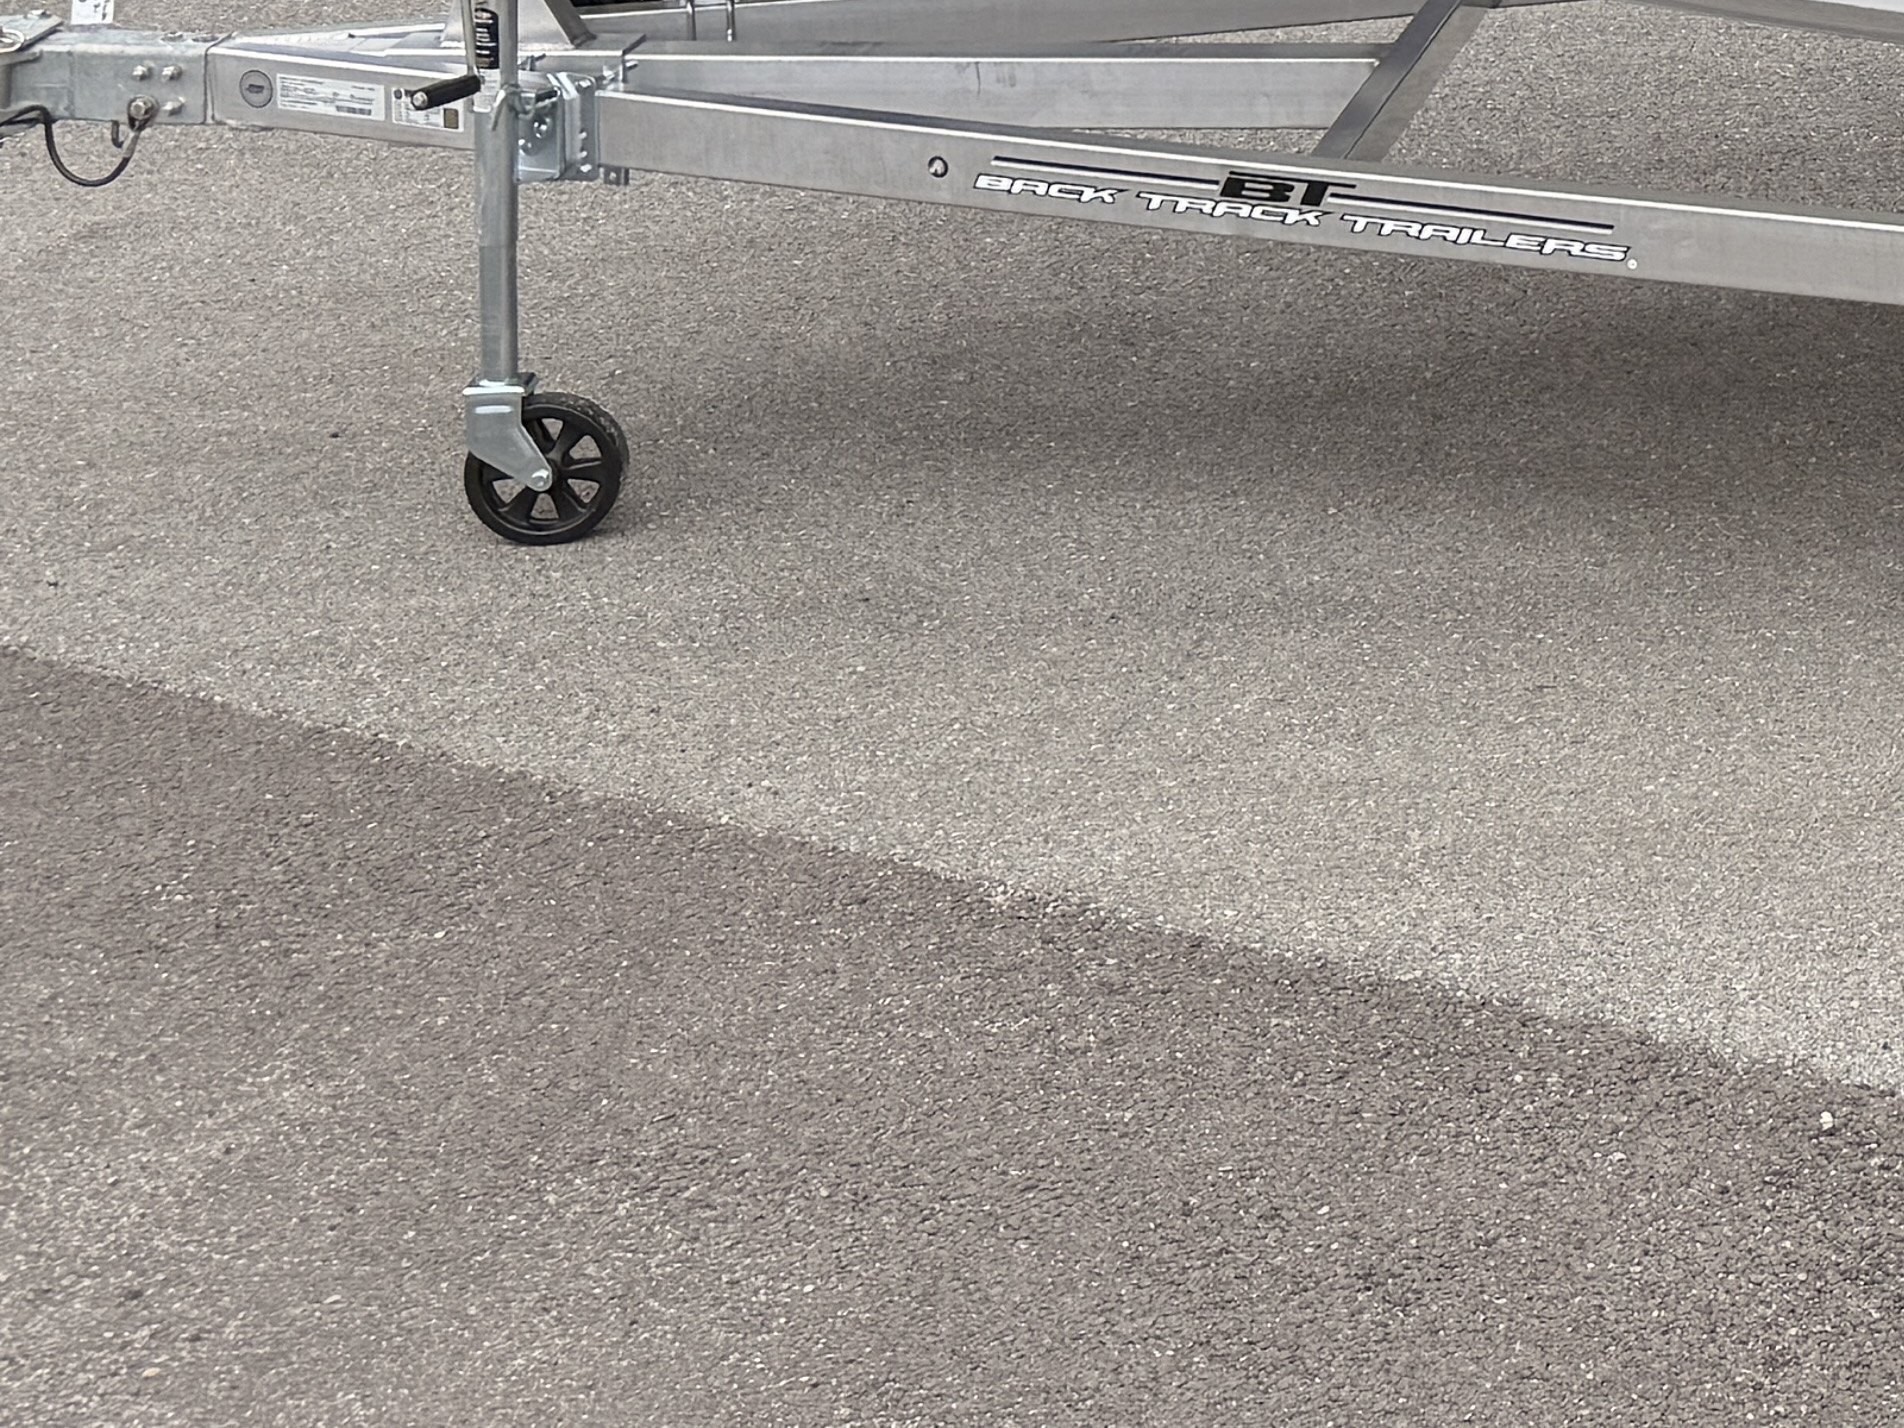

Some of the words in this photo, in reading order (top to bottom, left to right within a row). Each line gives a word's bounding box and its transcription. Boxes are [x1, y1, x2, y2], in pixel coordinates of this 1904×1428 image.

[973, 171, 1128, 206] BACK
[1136, 188, 1334, 229] TRACK
[1340, 211, 1631, 261] TRAILERS
[1219, 169, 1357, 208] BT
